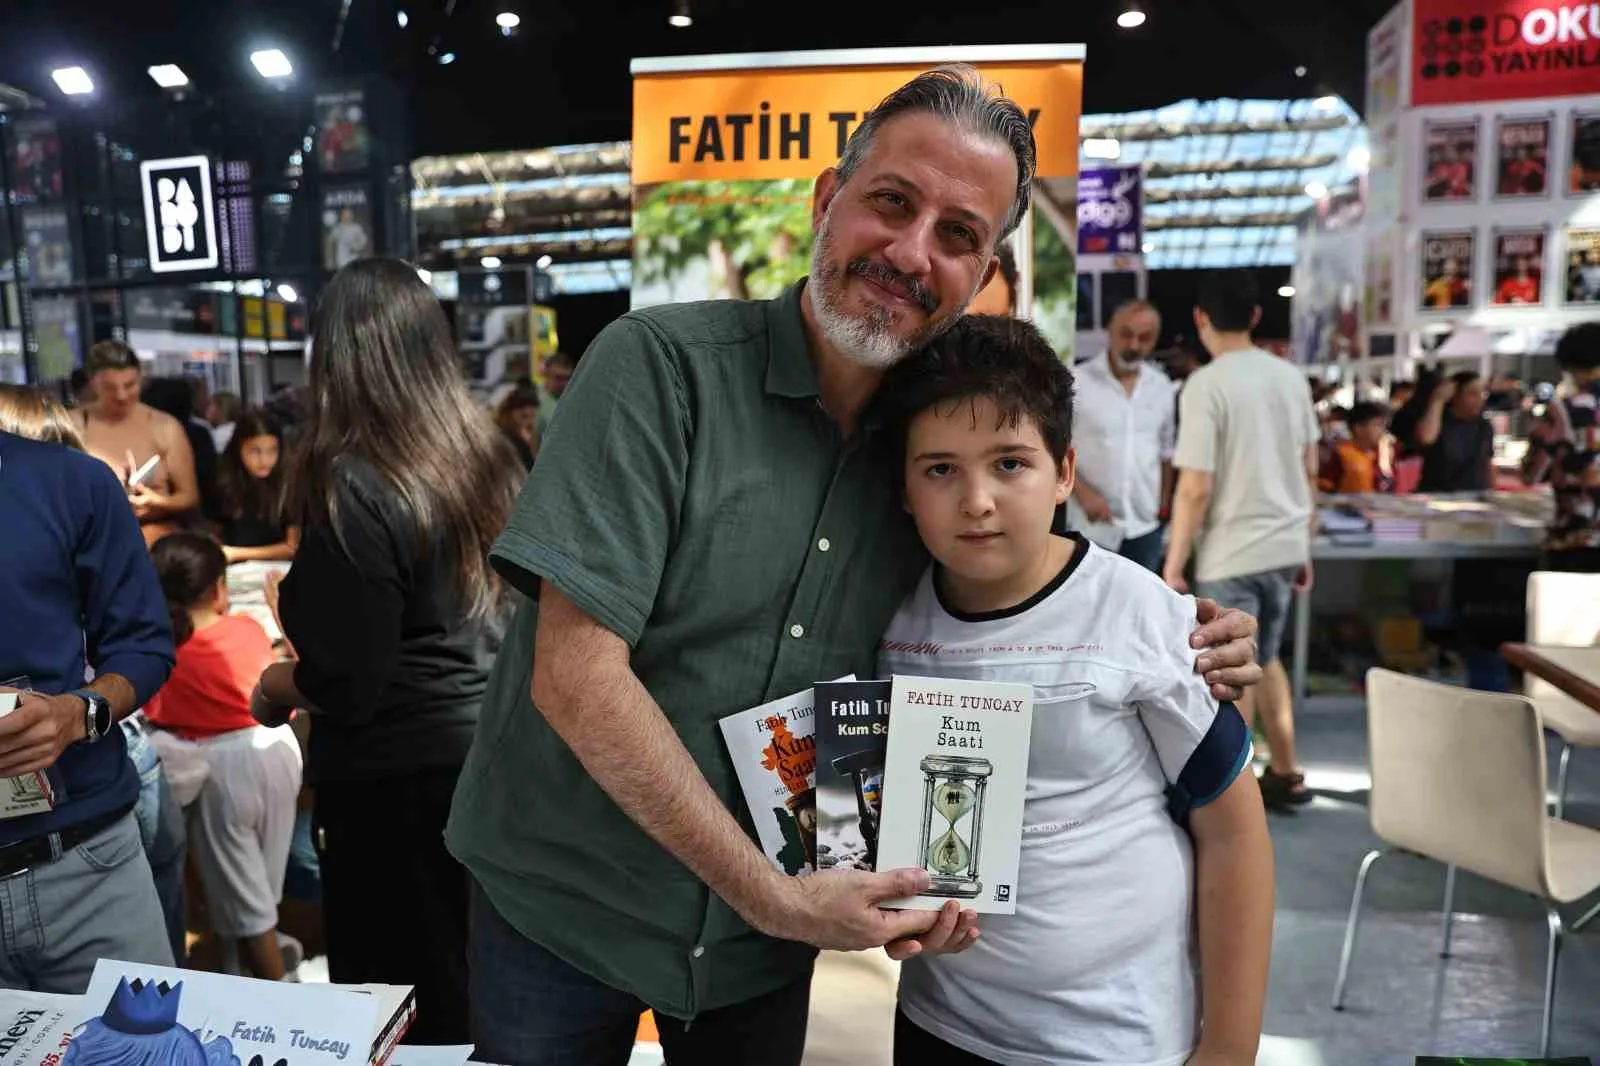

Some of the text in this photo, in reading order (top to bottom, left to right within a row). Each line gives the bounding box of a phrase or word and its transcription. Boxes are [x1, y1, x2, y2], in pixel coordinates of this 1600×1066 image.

[669, 101, 810, 163] FATİH
[831, 699, 869, 716] Fatih
[906, 690, 1023, 713] FATİH TUNCAY
[838, 723, 869, 736] Kum
[942, 716, 981, 732] Kum
[937, 732, 983, 749] Saati
[231, 1021, 276, 1044] Fatih
[289, 1028, 351, 1060] Tuncay
